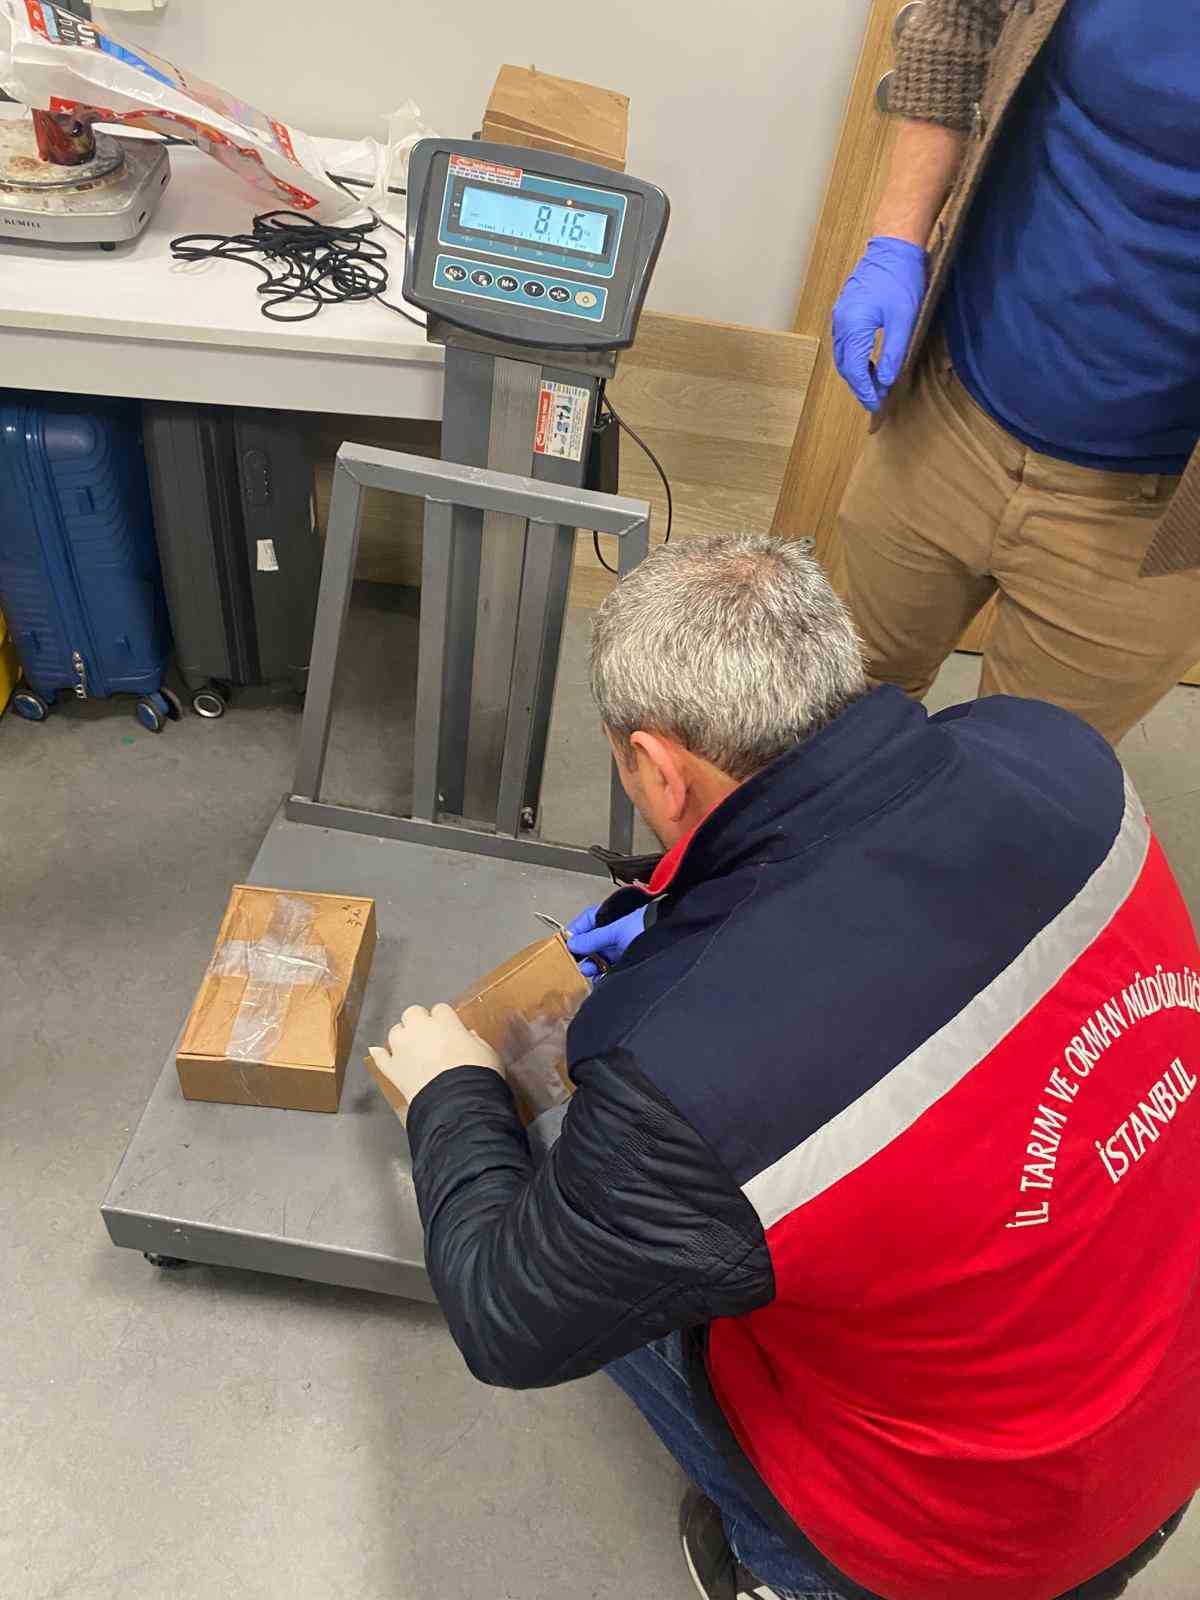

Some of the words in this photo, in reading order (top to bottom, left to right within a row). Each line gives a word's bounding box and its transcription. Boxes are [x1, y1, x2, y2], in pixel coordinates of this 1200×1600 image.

[1064, 997, 1128, 1077] ORMAN
[1044, 1066, 1079, 1104] VE
[1094, 1057, 1198, 1184] İSTANBUL
[1020, 1103, 1068, 1192] TARIM
[1005, 1201, 1049, 1230] İL
